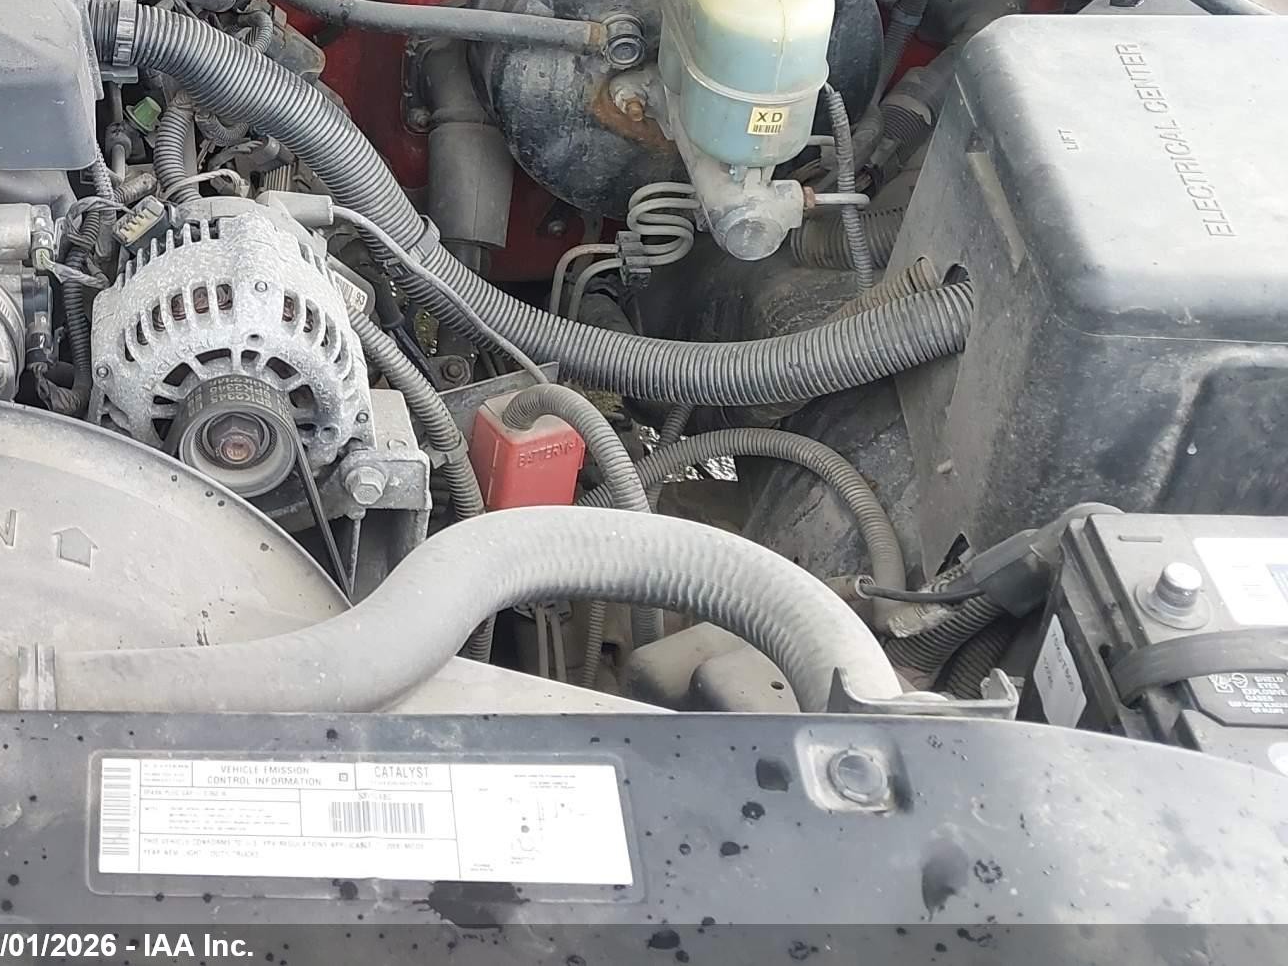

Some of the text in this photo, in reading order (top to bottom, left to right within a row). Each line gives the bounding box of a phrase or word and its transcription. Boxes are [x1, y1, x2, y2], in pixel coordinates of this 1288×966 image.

[1058, 129, 1080, 151] LIFT
[1115, 43, 1238, 237] ELECTRICAL CENTER
[220, 765, 310, 775] VEHICLE EMISSION
[374, 766, 429, 779] CATALYST
[207, 776, 322, 786] CONTROL INFORMATION
